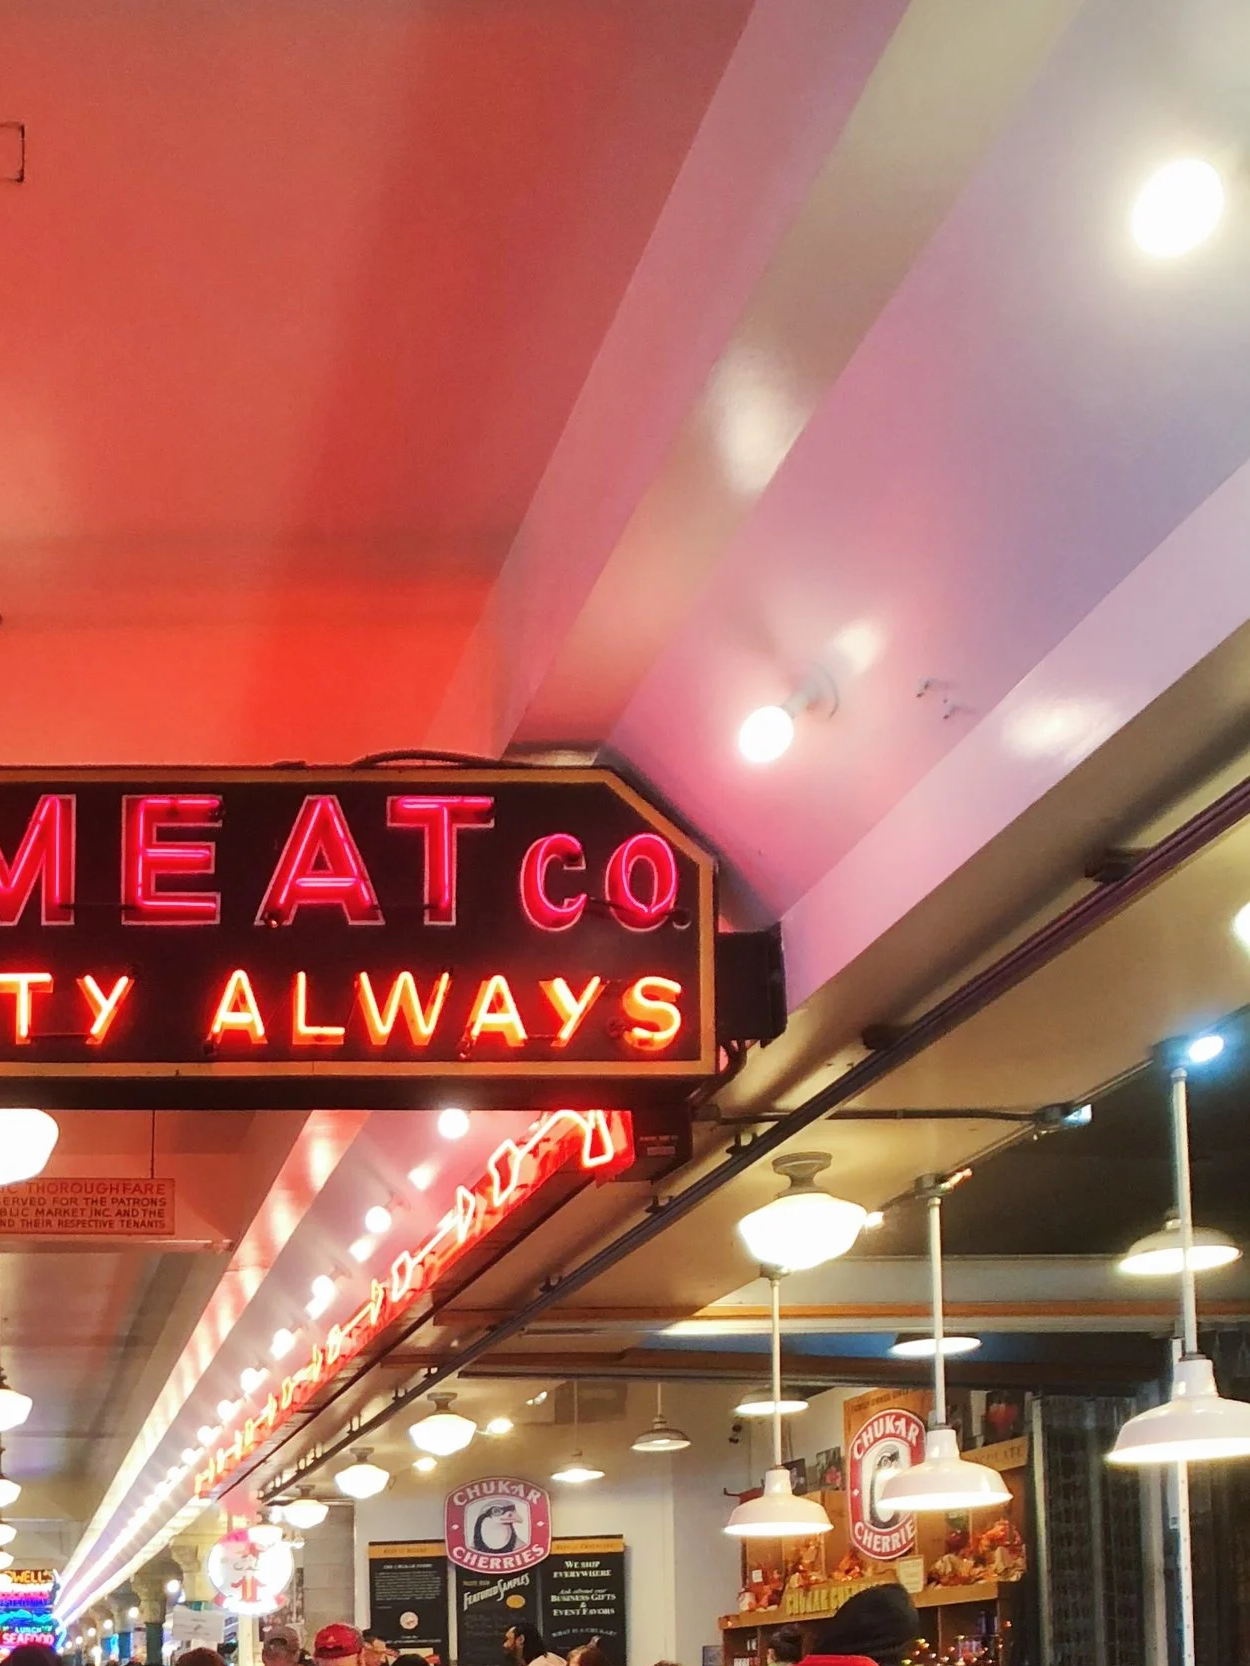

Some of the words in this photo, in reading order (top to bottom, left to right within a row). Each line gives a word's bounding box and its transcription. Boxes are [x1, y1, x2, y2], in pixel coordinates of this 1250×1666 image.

[207, 969, 683, 1052] ALWAYS
[27, 1182, 165, 1195] THOROUGHFARE
[35, 1208, 85, 1218] MARKET
[115, 1208, 138, 1218] AND
[142, 1208, 165, 1218] THE
[53, 1197, 78, 1206] FOR
[83, 1197, 107, 1206] THE
[111, 1197, 167, 1207] PATRONS
[20, 1219, 52, 1228] THEIR
[58, 1219, 115, 1229] RESPECTIVE
[120, 1219, 165, 1229] TENANTS
[853, 1415, 920, 1460] CHUKAR
[452, 1479, 543, 1507] CHUKAR
[854, 1522, 917, 1553] CHERRIE
[452, 1544, 545, 1570] CHERRIES
